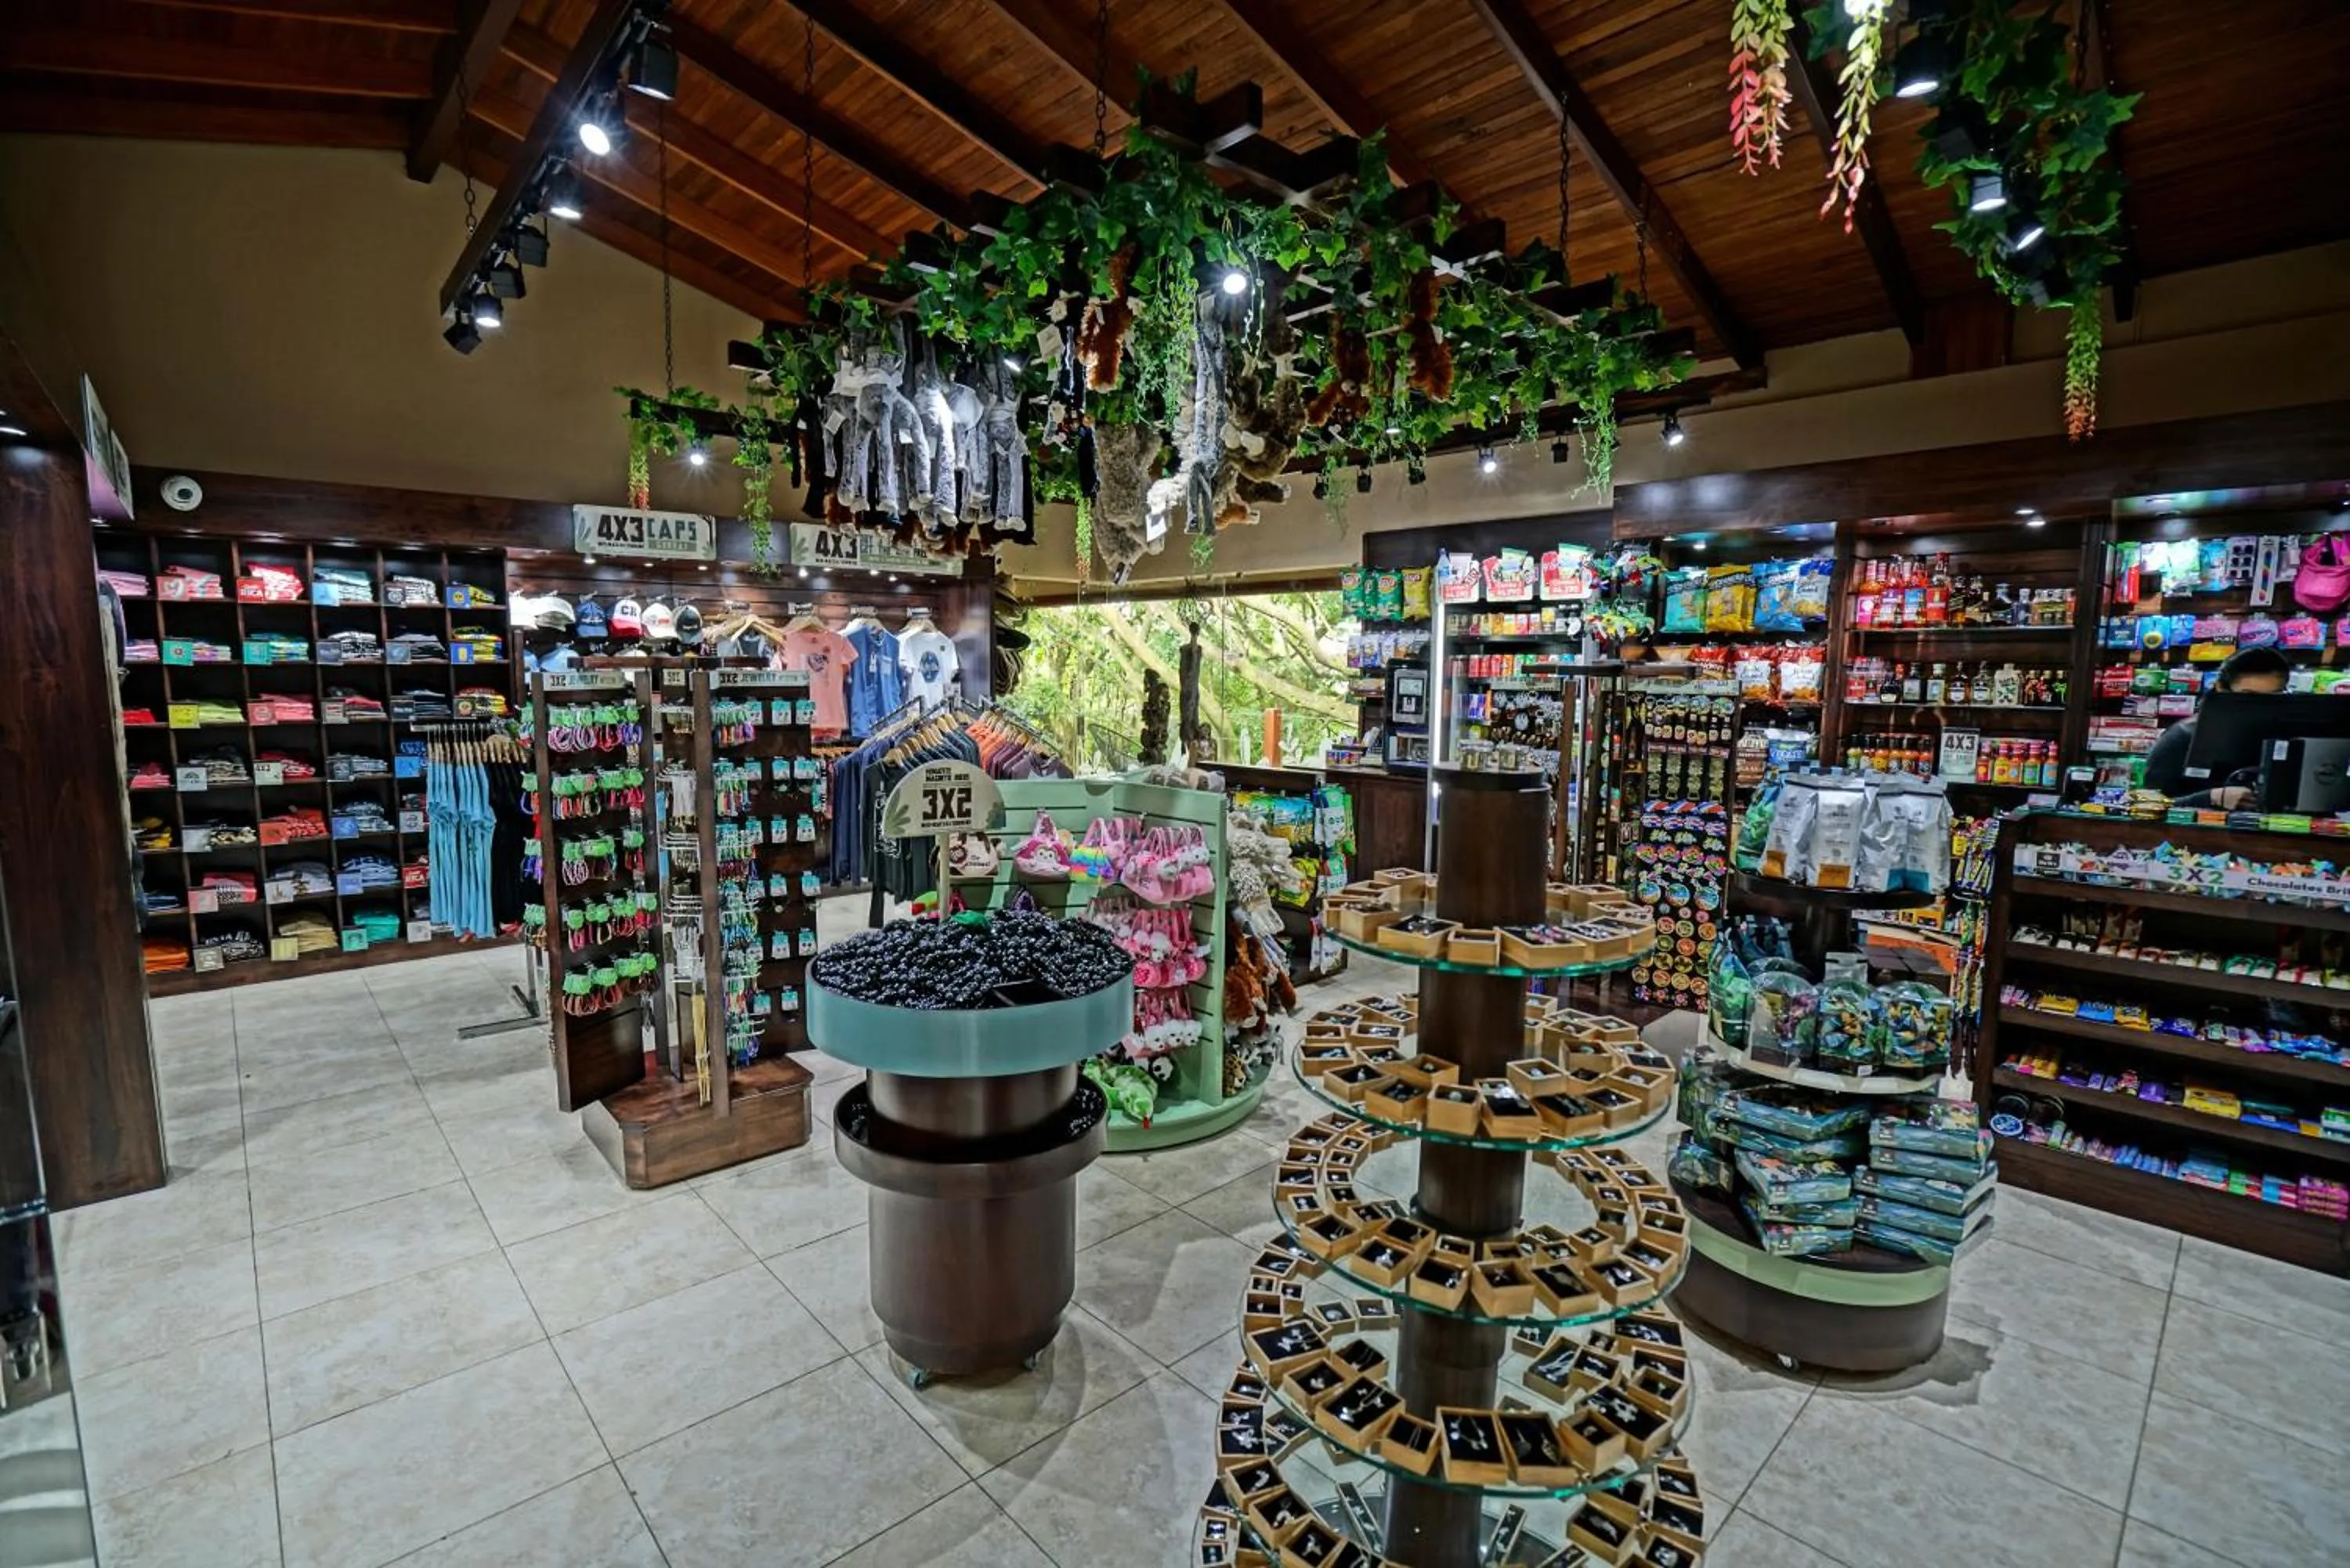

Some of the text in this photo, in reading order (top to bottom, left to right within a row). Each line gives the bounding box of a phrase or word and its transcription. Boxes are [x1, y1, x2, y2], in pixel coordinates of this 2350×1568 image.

[598, 514, 697, 543] 4X3 CAPS
[815, 530, 858, 558] 4X3
[719, 673, 738, 684] 3X2
[1944, 735, 1975, 750] 4X3
[923, 788, 972, 820] 3X2
[2247, 876, 2323, 894] Chocolates
